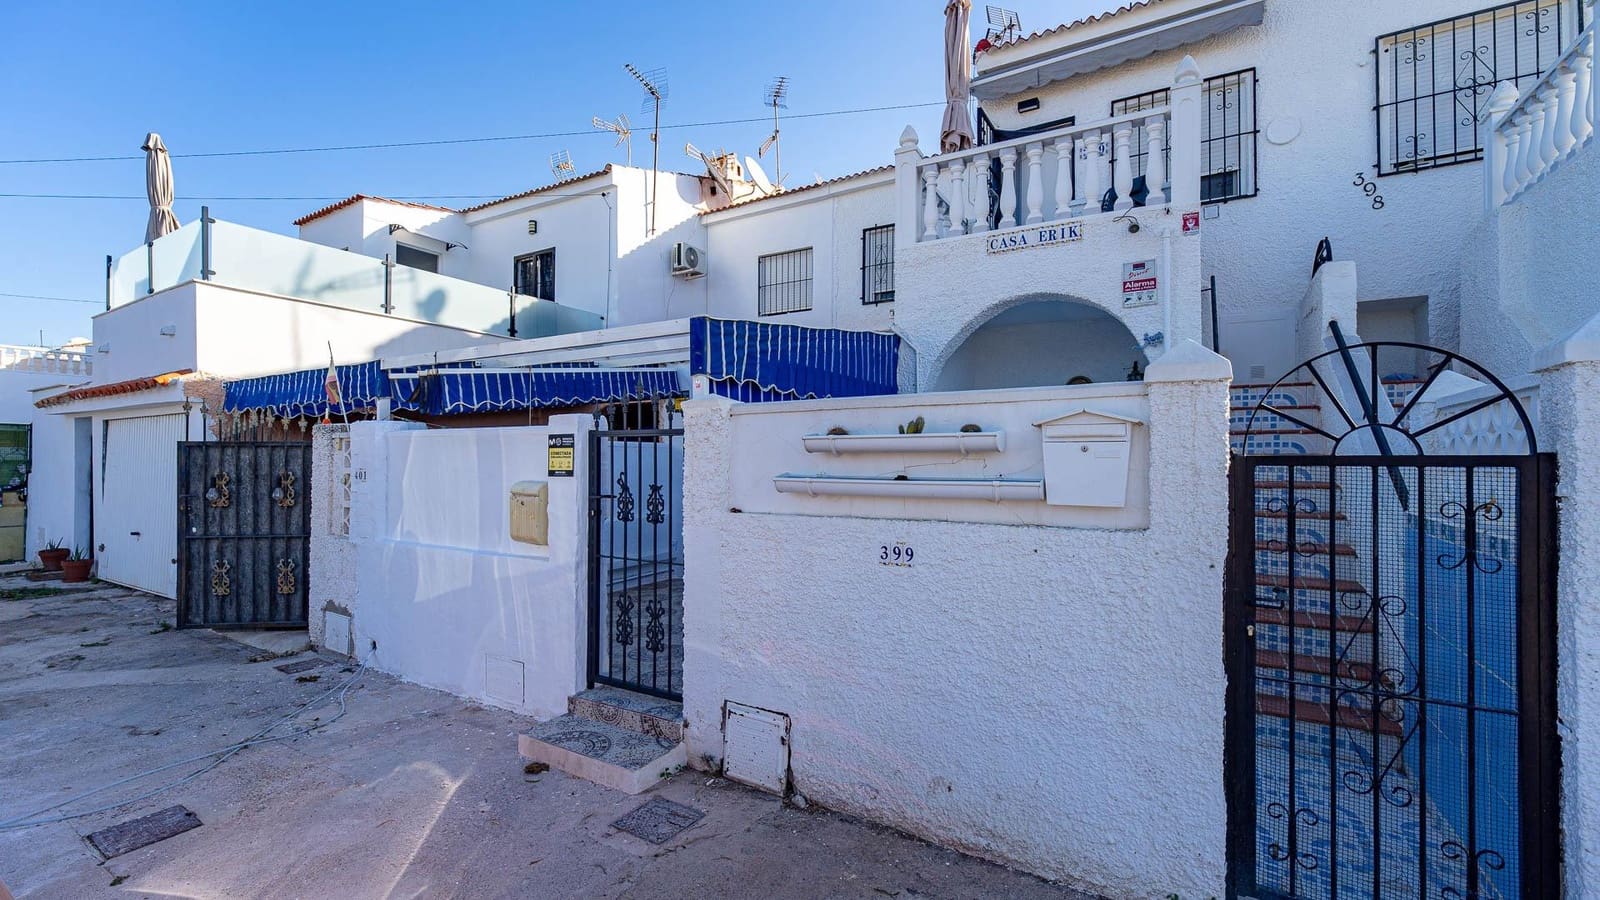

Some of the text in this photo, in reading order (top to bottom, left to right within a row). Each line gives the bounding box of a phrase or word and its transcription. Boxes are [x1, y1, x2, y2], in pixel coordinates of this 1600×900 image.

[1353, 172, 1384, 210] 398
[990, 225, 1078, 250] CASA ERIK
[1124, 280, 1155, 289] Alarma
[880, 545, 914, 563] 399
